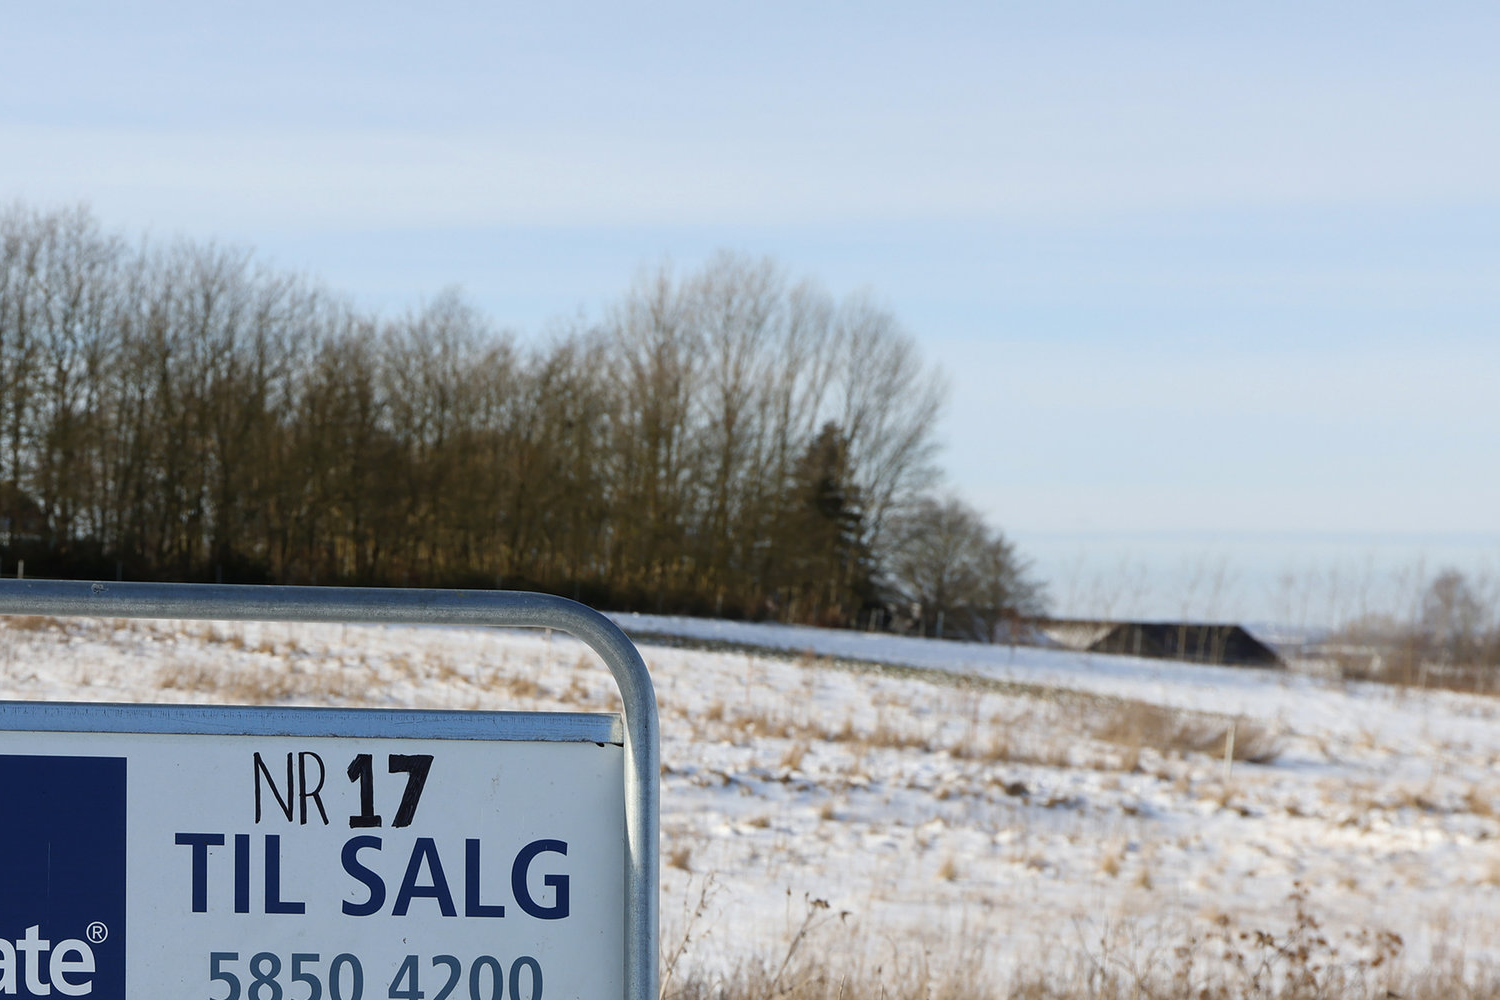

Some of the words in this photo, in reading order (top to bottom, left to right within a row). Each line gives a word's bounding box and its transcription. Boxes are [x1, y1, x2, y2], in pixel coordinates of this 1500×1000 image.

[253, 751, 330, 826] NR
[346, 753, 435, 829] 17
[174, 832, 306, 915] TIL
[340, 835, 570, 920] SALG
